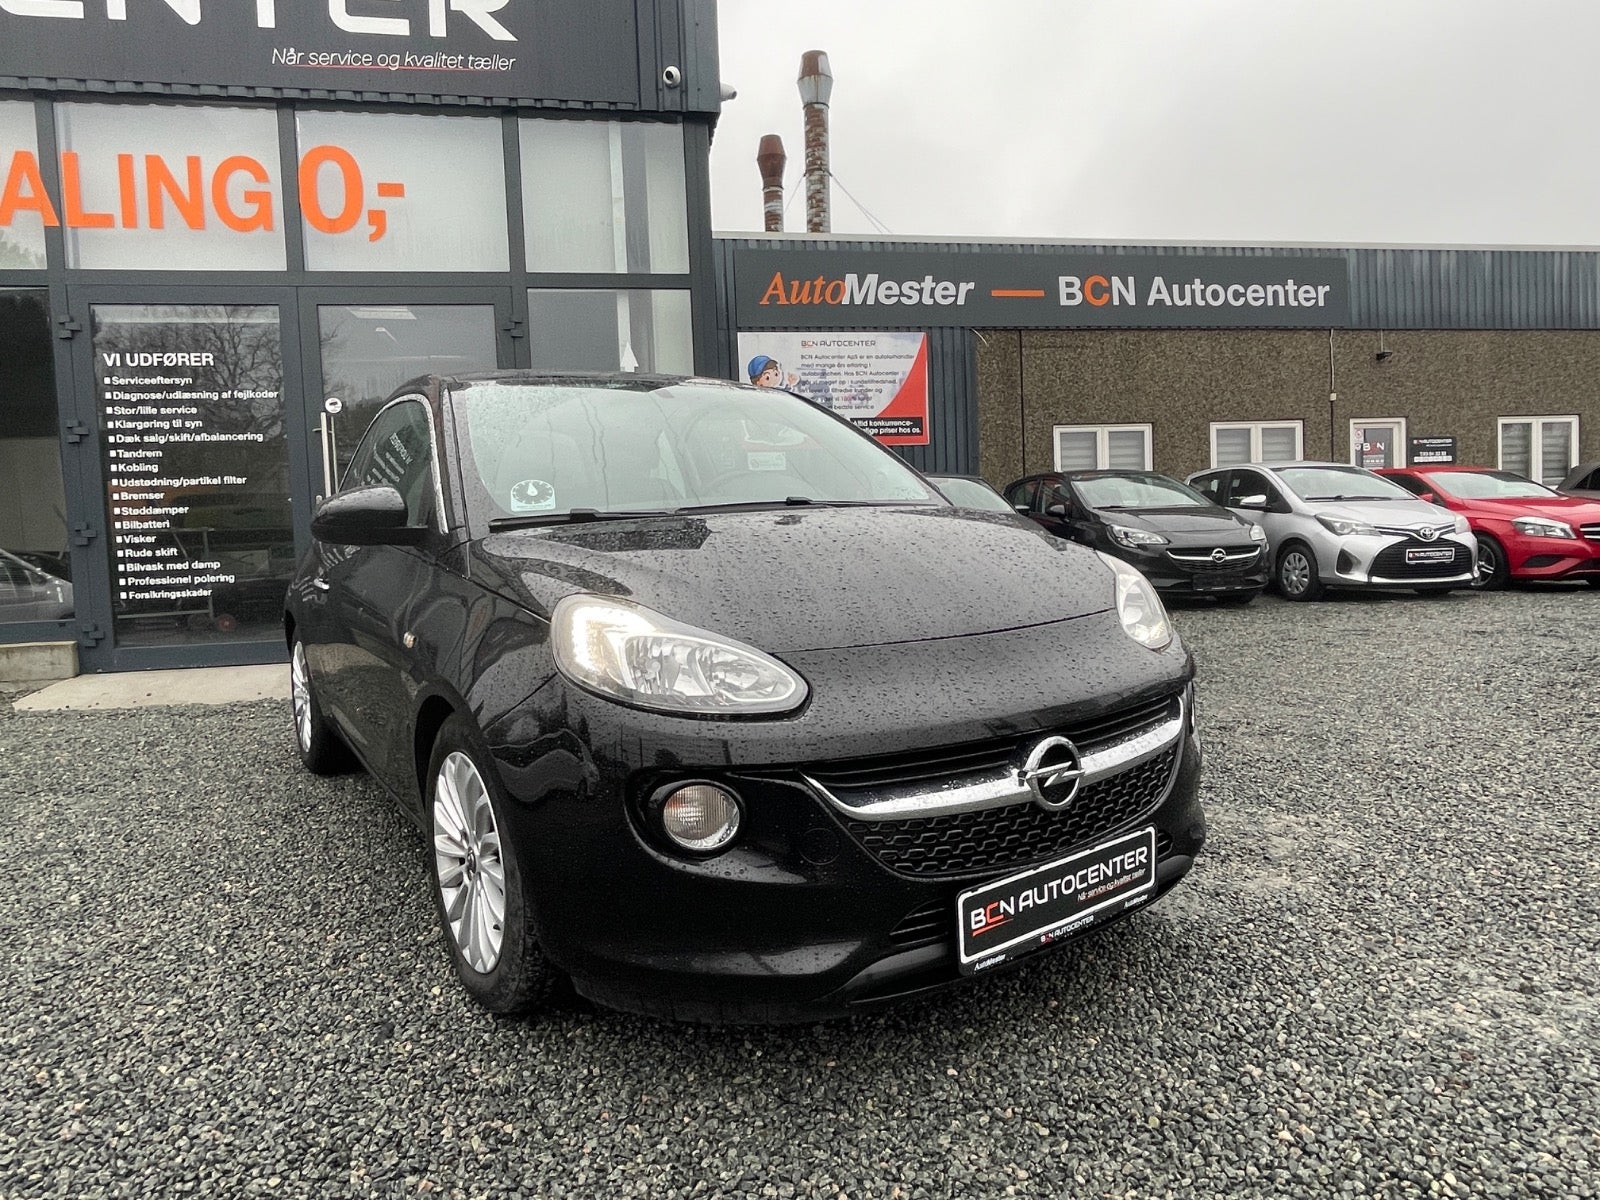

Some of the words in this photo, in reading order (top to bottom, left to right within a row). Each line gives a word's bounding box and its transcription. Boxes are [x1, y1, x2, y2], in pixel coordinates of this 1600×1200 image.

[272, 47, 304, 65] Når
[308, 50, 372, 66] service
[377, 54, 400, 70] og
[404, 51, 464, 68] kvalitet
[468, 54, 516, 71] tæller
[760, 272, 975, 306] AutoMester
[1059, 275, 1136, 306] BCN
[1147, 276, 1330, 308] Autocenter
[103, 353, 121, 367] VI
[126, 352, 214, 367] UDFØRER
[112, 376, 192, 386] Serviceeftersyn
[113, 391, 219, 401] Diagnose/udlæsning
[221, 390, 232, 399] af
[233, 390, 279, 400] fejlkoder
[114, 406, 158, 415] Stor/lille
[160, 406, 198, 415] service
[115, 420, 170, 430] Klargøring
[172, 420, 183, 428] til
[184, 420, 203, 430] syn
[116, 434, 141, 443] Dæk
[143, 432, 264, 444] salg/skift/afbalancering
[117, 450, 162, 458] Tandrem
[118, 463, 159, 473] Kobling
[120, 476, 221, 488] Udstødning/partikel
[224, 476, 247, 484] filter
[121, 492, 165, 500] Bremser
[122, 506, 189, 516] Støddæmper
[122, 520, 170, 529] Bilbatteri
[124, 535, 156, 544] Visker
[125, 549, 153, 558] Rude
[155, 548, 178, 557] skift
[126, 563, 164, 572] Bilvask
[166, 562, 189, 571] med
[191, 561, 220, 571] damp
[128, 576, 192, 586] Professionel
[194, 574, 236, 584] polering
[129, 589, 212, 600] Forsikringsskader
[970, 896, 1015, 930] BCN
[1018, 846, 1148, 913] AUTOCENTER
[1055, 915, 1094, 937] AUTOCENTER
